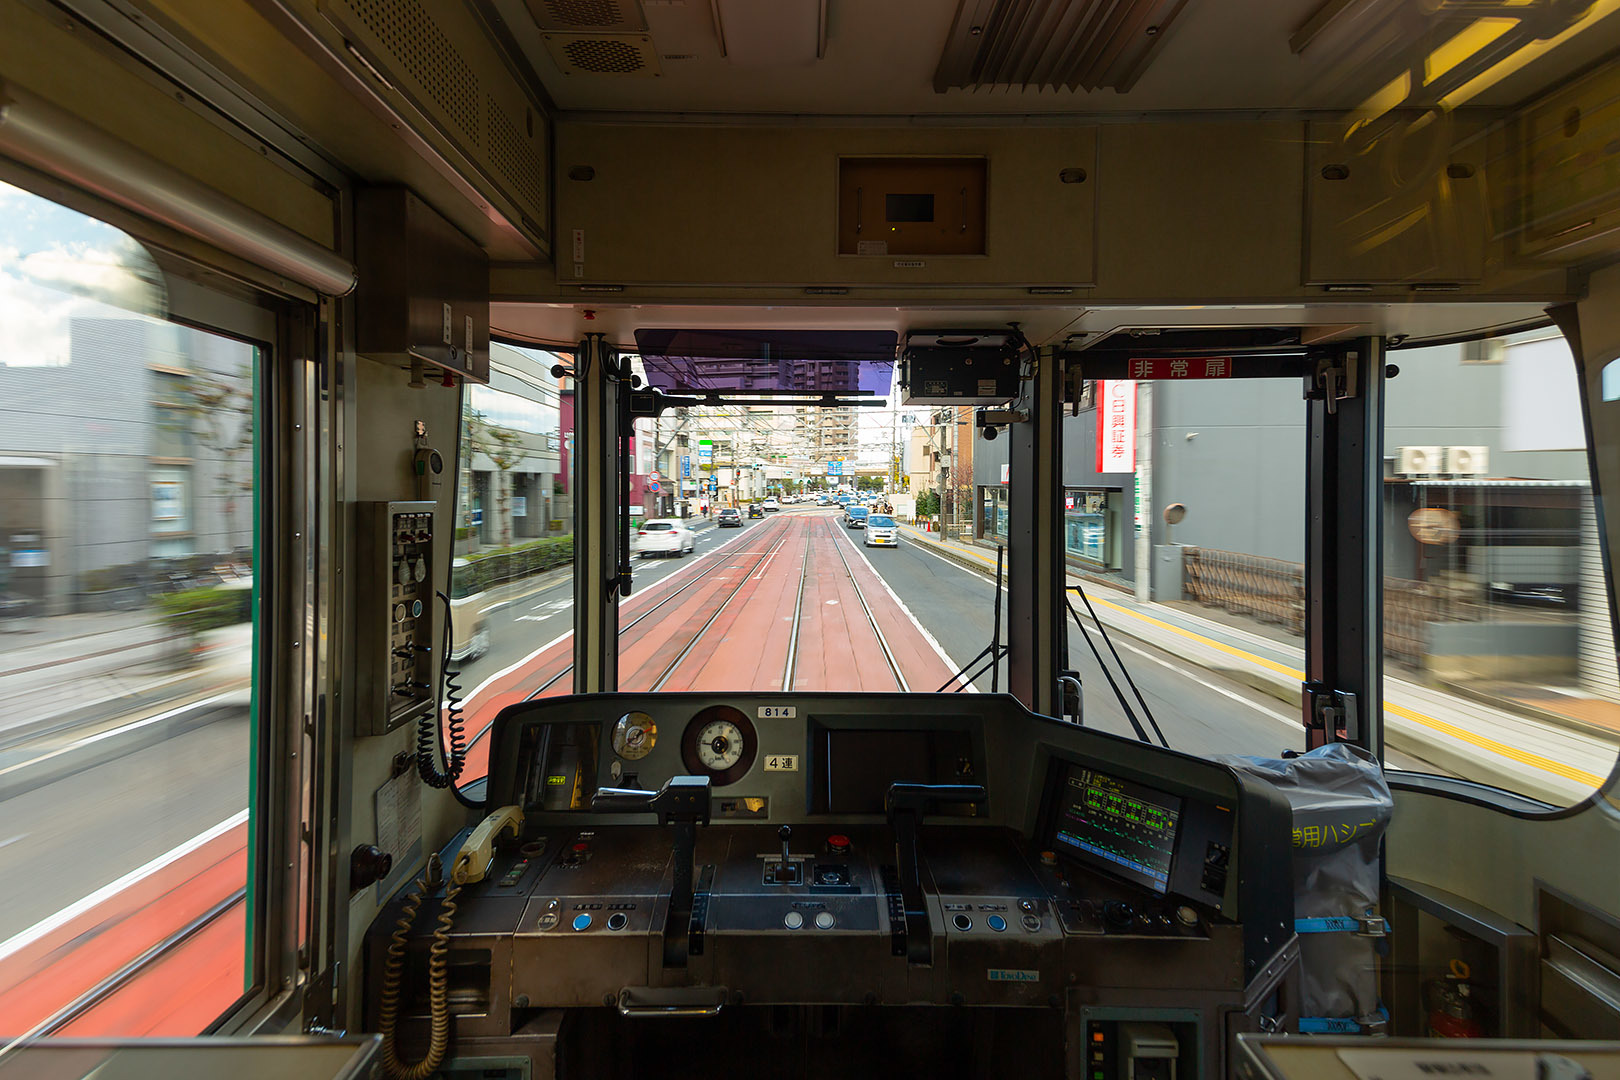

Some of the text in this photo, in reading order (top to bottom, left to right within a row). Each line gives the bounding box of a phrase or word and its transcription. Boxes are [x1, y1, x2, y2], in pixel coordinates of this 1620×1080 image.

[1134, 358, 1225, 378] 非常扉
[764, 707, 789, 717] 814
[769, 757, 793, 769] 4連
